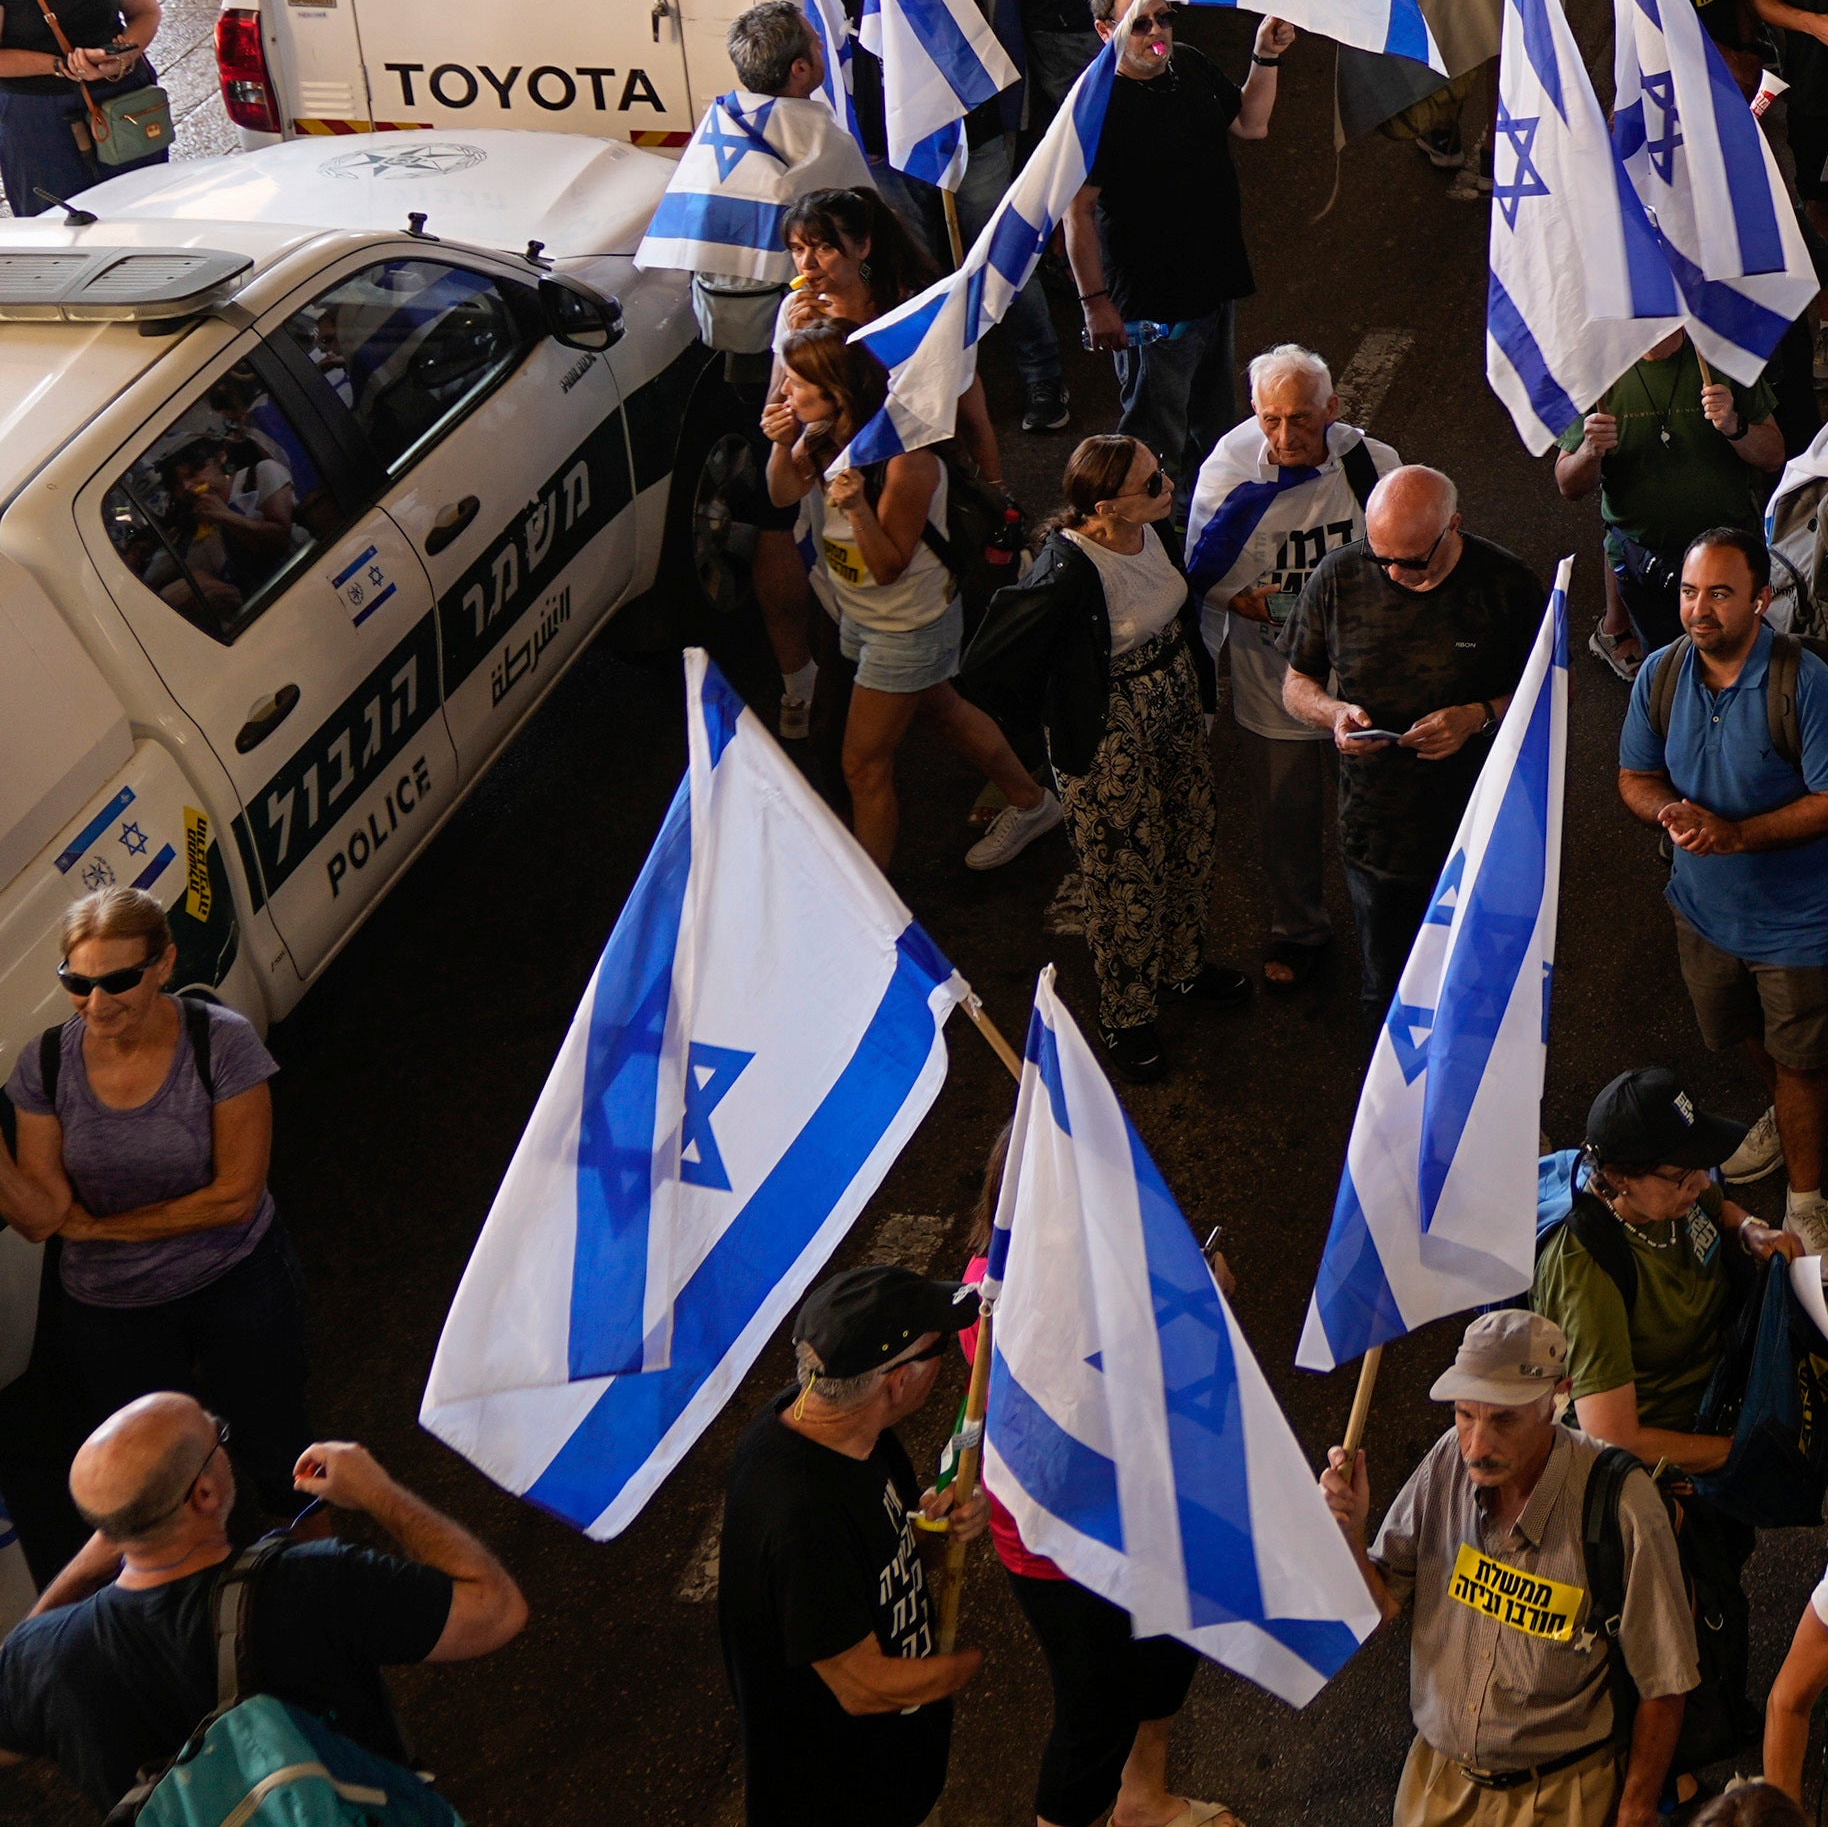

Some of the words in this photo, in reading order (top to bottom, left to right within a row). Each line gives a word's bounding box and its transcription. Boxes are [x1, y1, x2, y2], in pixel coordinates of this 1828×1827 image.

[384, 63, 668, 113] TOYOTA
[463, 461, 593, 635] משמר
[490, 585, 573, 708] الشرطة
[268, 673, 421, 867] הגבול
[327, 757, 433, 900] POLICE
[1455, 1571, 1503, 1619] וביזה
[1473, 1559, 1553, 1606] ממשלת
[1502, 1597, 1570, 1640] חורבן
